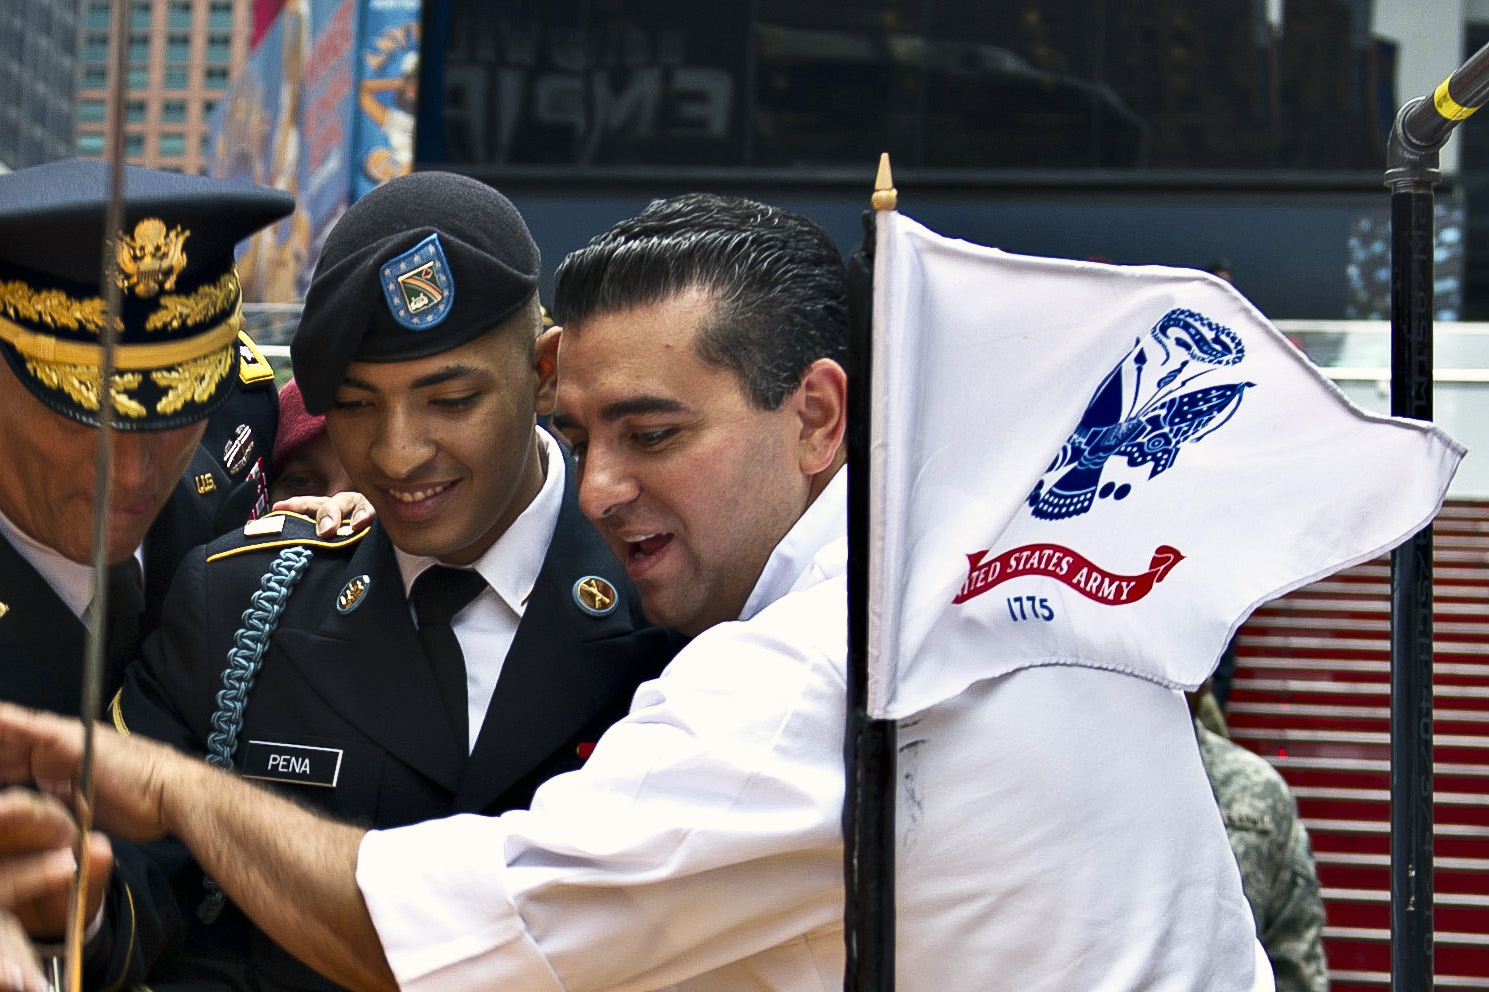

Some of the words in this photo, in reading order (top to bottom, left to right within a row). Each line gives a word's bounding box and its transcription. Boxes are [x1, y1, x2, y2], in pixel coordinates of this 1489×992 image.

[1006, 549, 1073, 576] STATES
[1072, 567, 1136, 601] ARMY
[1007, 595, 1055, 622] 1775
[267, 754, 310, 774] PENA
